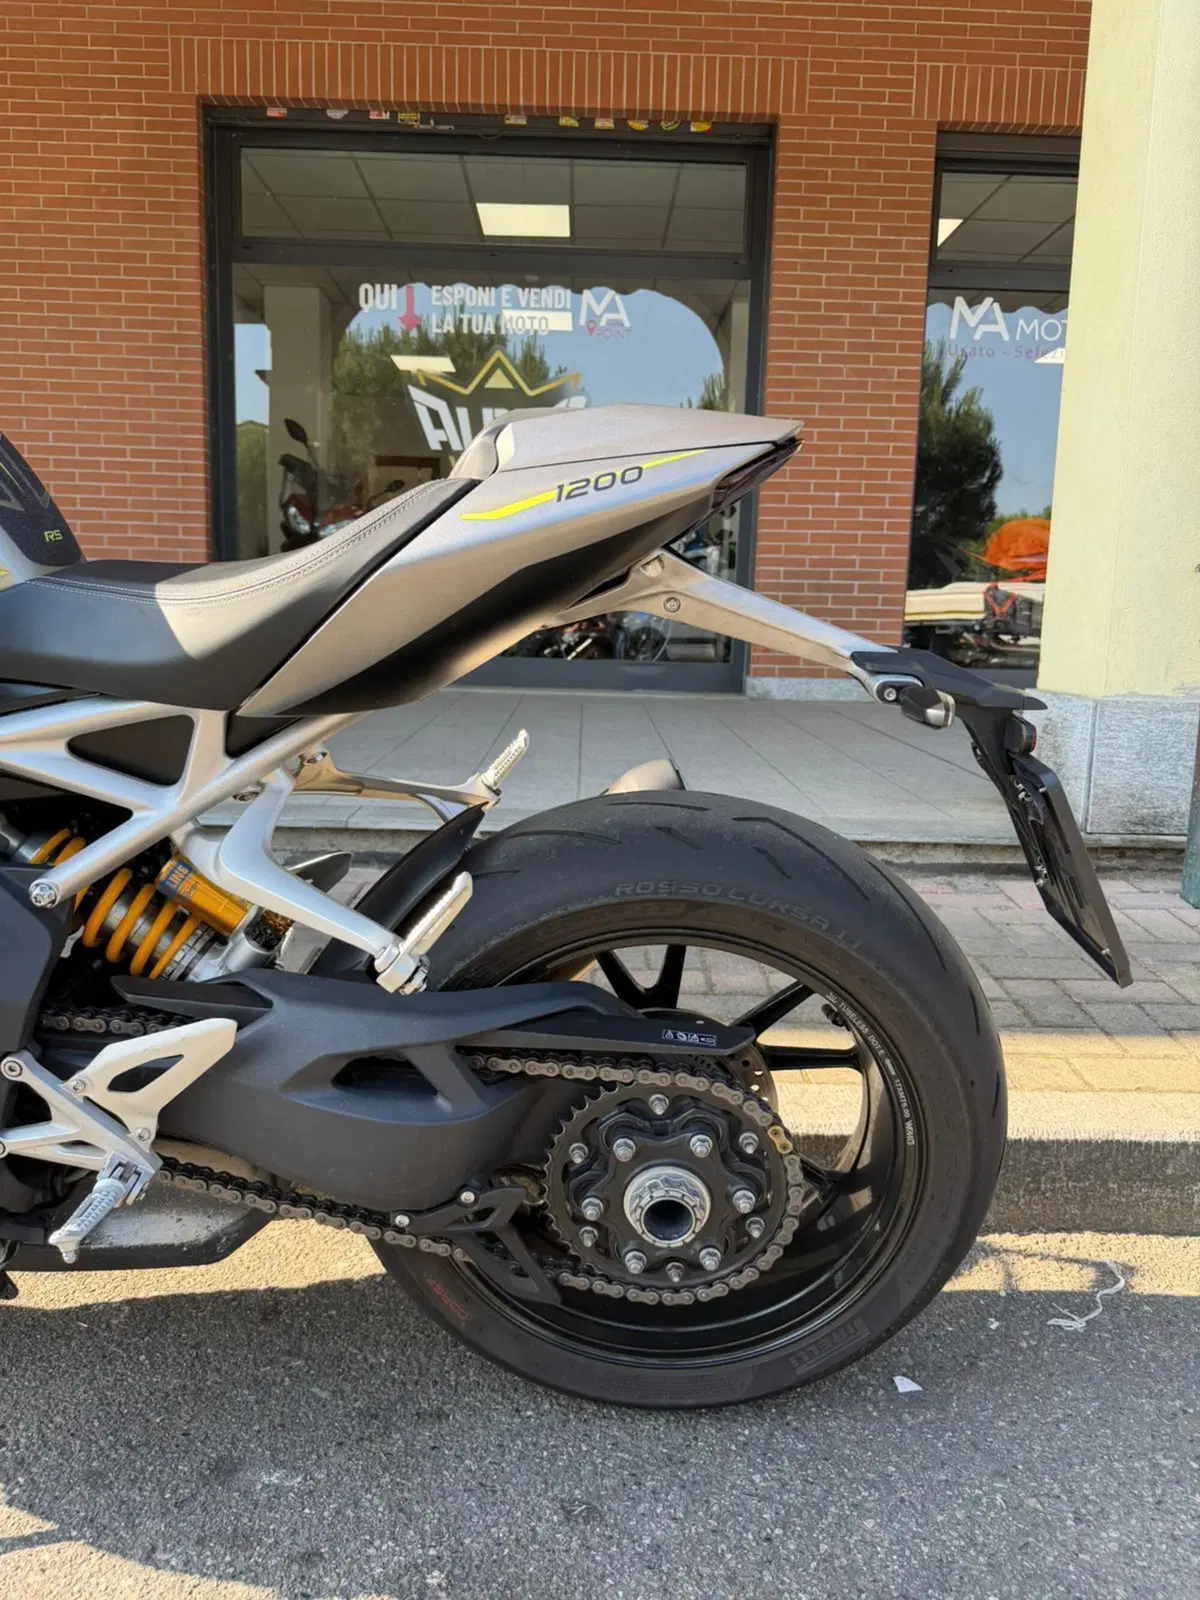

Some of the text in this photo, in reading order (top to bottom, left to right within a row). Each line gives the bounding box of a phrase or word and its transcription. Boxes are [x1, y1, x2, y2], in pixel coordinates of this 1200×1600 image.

[359, 283, 398, 312] QUI
[431, 285, 572, 309] ESPONI E VENDI
[432, 313, 549, 336] LA TUA MOTO
[555, 465, 644, 502] 1200
[44, 529, 63, 542] RS
[615, 880, 723, 897] ROSSO
[727, 887, 831, 931] CORSA
